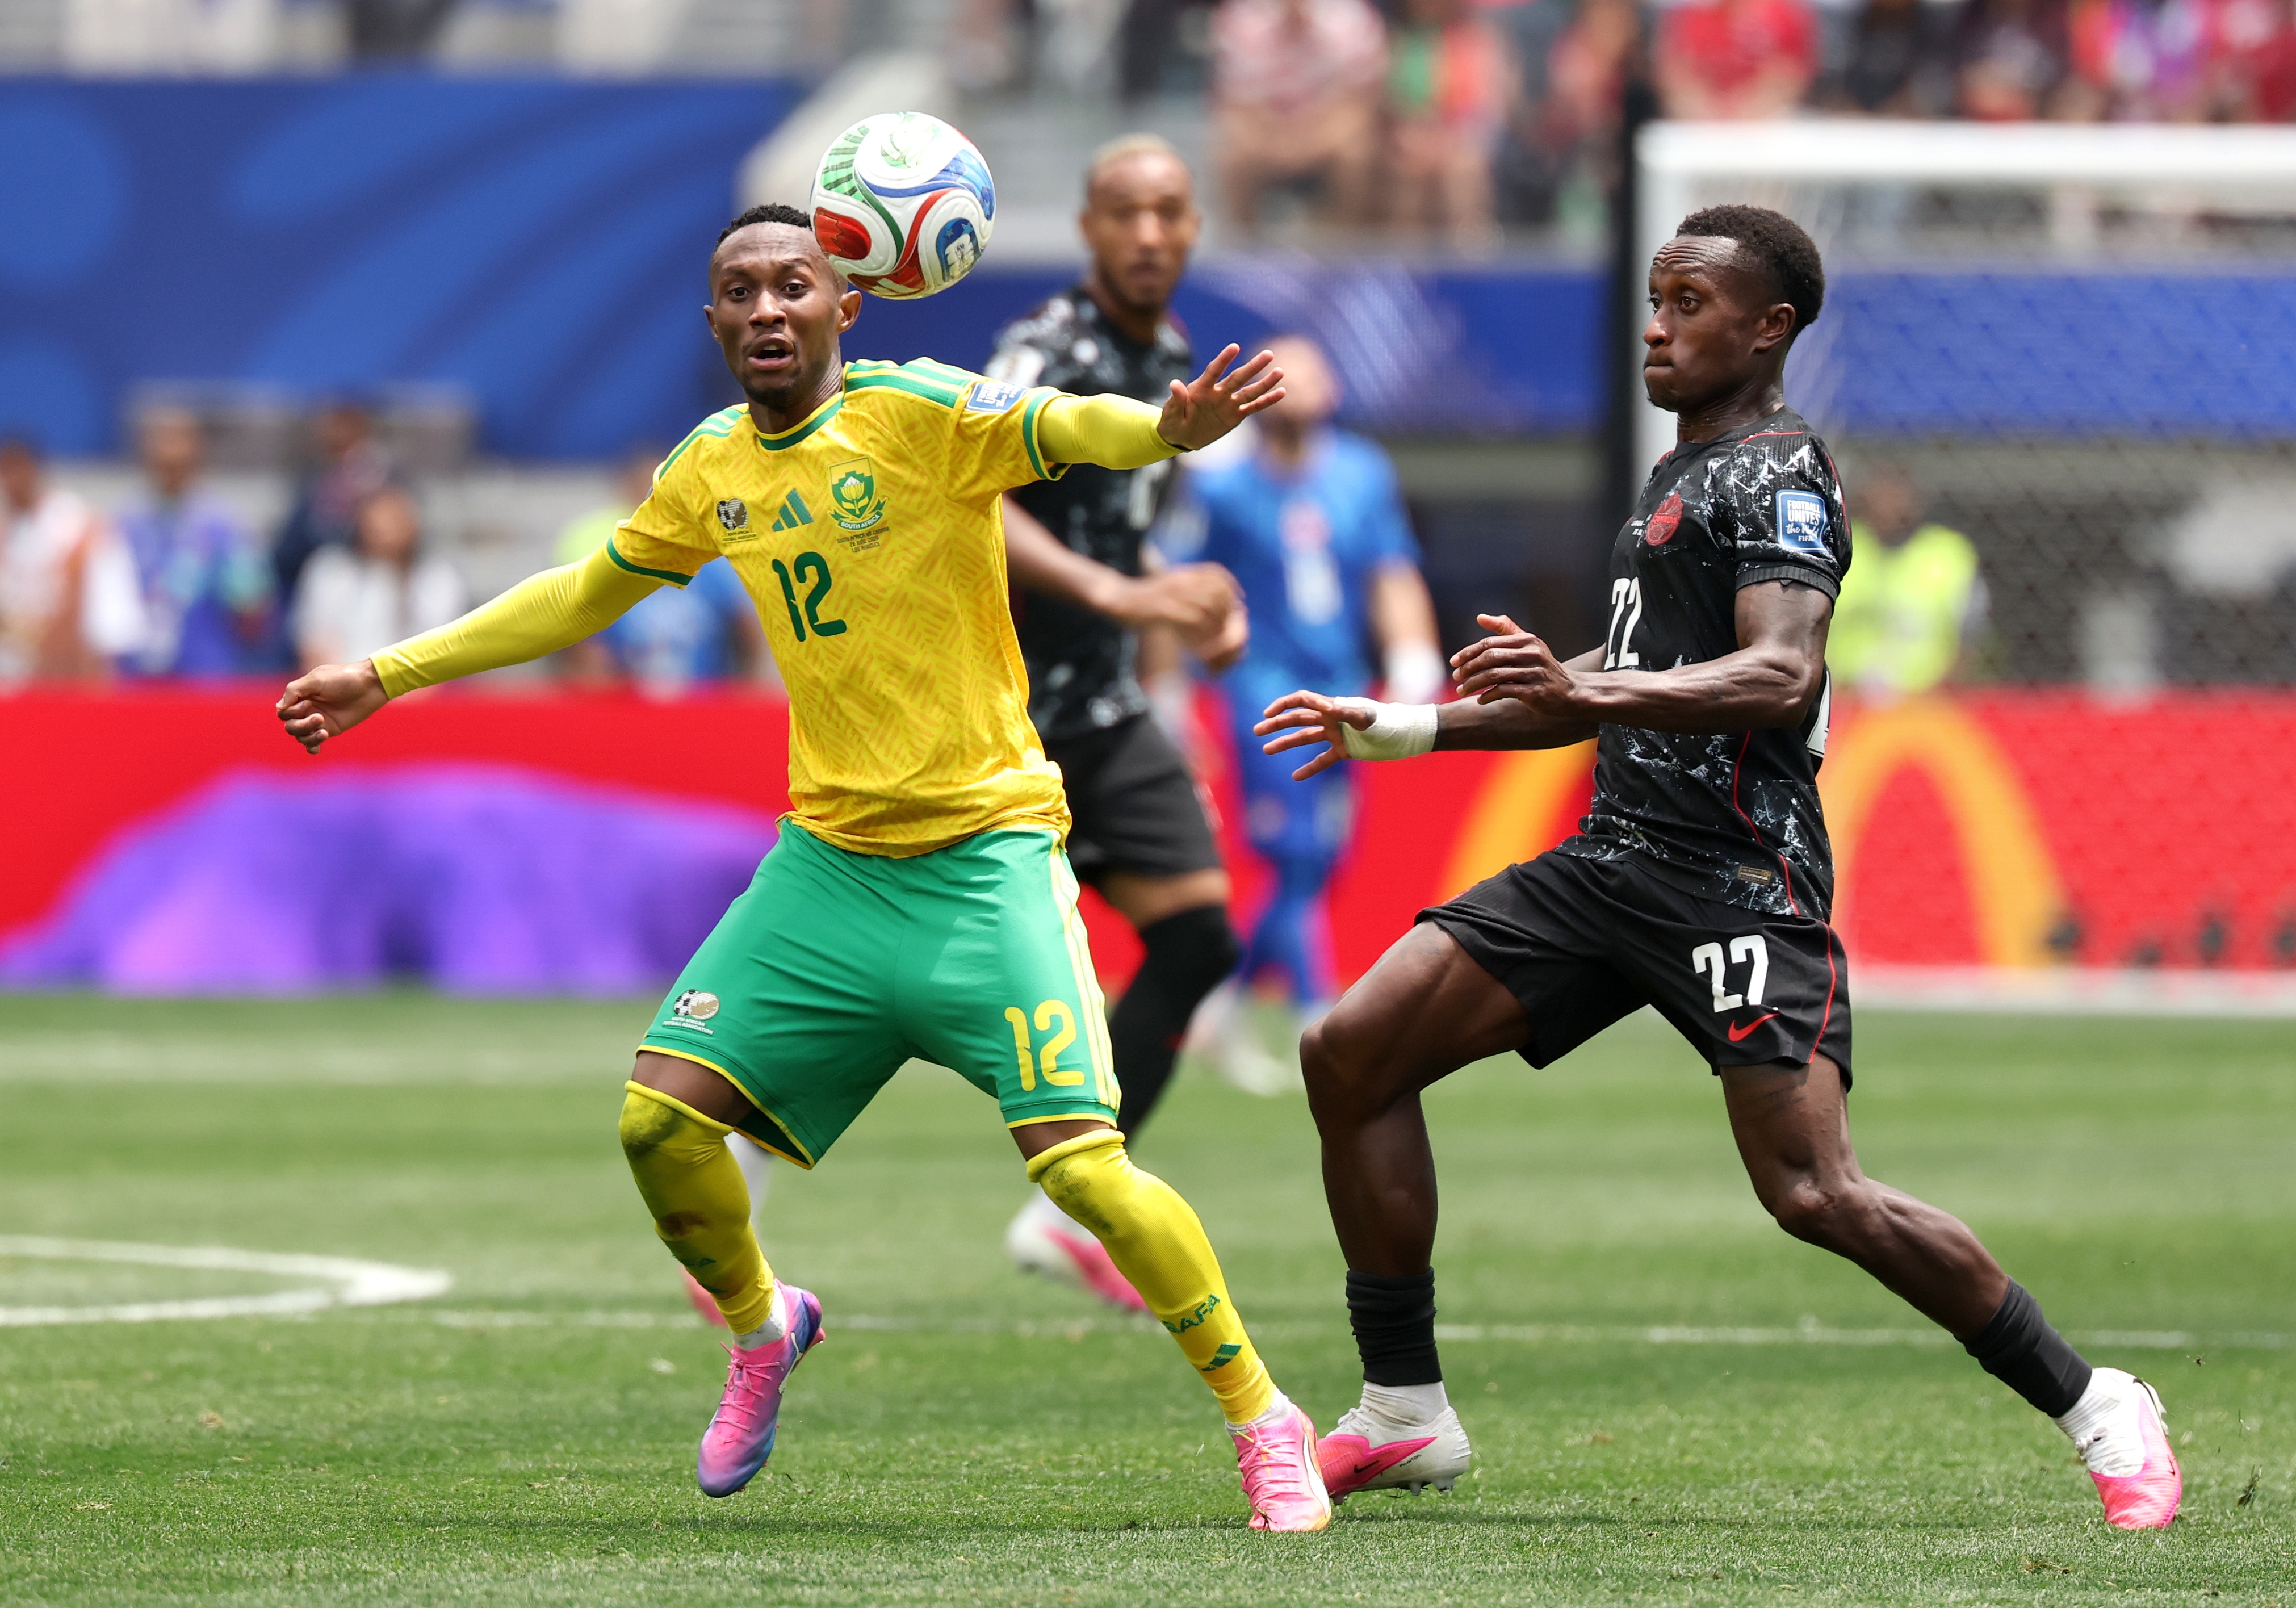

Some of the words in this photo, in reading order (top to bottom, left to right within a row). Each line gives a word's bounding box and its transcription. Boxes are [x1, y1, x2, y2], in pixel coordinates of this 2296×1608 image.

[1787, 500, 1820, 513] FOOTBALL
[861, 514, 880, 528] AFRICA
[1787, 509, 1821, 526] UNITES
[1786, 523, 1800, 534] the
[772, 551, 847, 642] 12
[1604, 576, 1643, 670] 22
[1004, 999, 1085, 1091] 12
